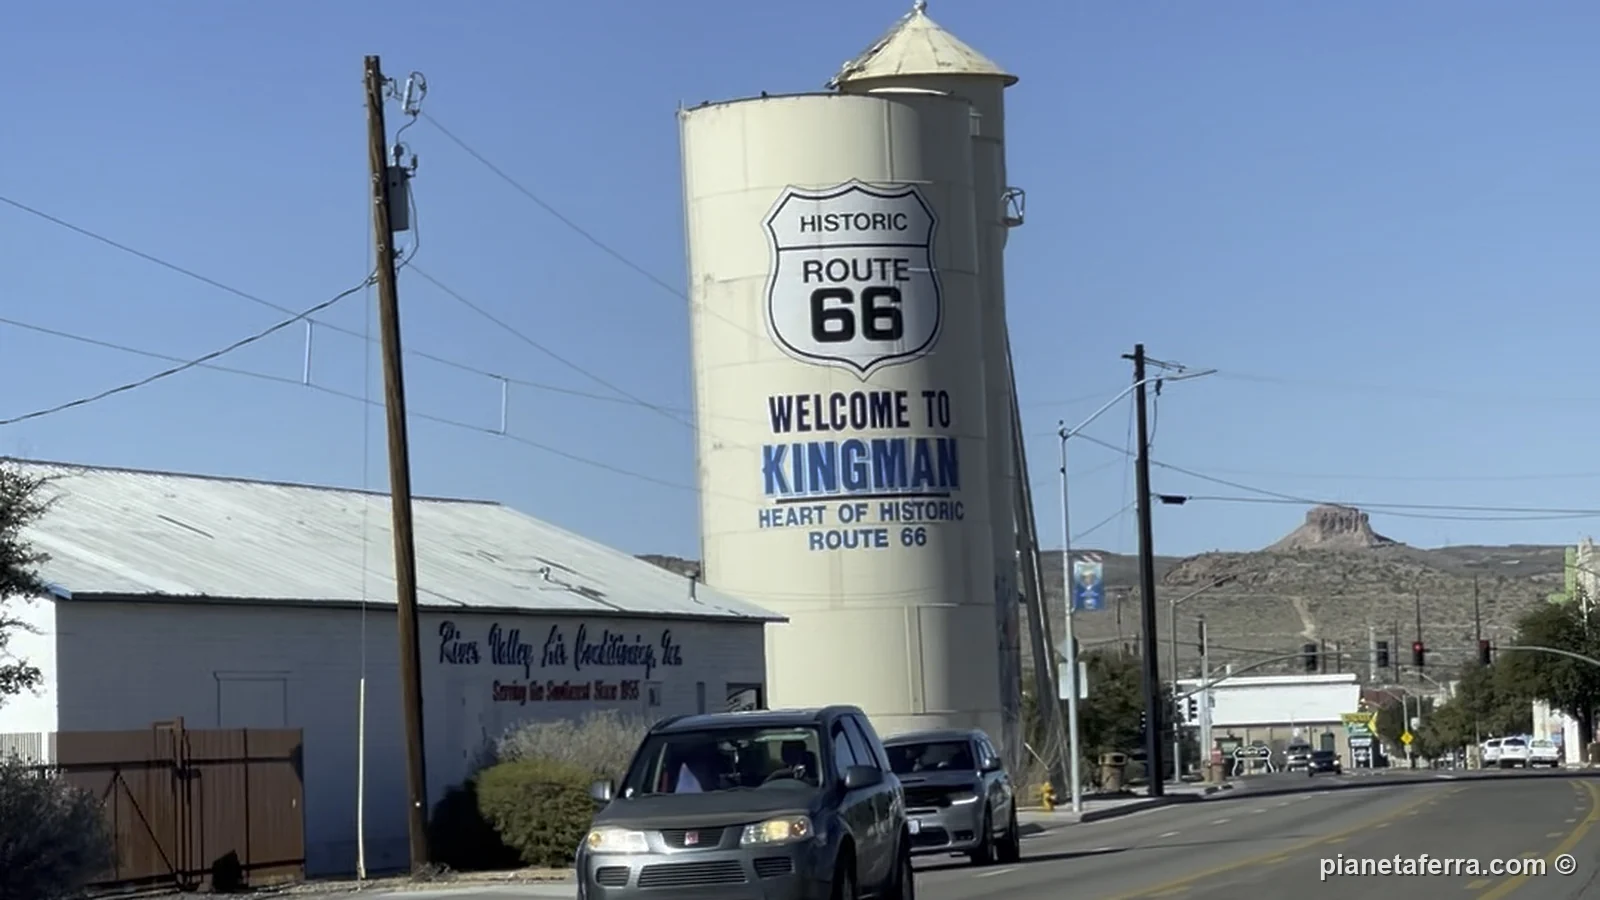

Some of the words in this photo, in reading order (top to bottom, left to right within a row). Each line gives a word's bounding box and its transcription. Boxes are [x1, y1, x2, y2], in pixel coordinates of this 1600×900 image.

[800, 212, 908, 233] HISTORIC
[802, 258, 910, 283] ROUTE
[810, 286, 904, 343] 66
[769, 391, 910, 433] WELCOME
[922, 390, 951, 429] TO
[762, 437, 960, 496] KINGMAN
[759, 505, 827, 528] HEART
[838, 503, 869, 524] OF
[880, 501, 964, 523] HISTORIC
[809, 529, 889, 551] ROUTE
[900, 527, 927, 547] 66
